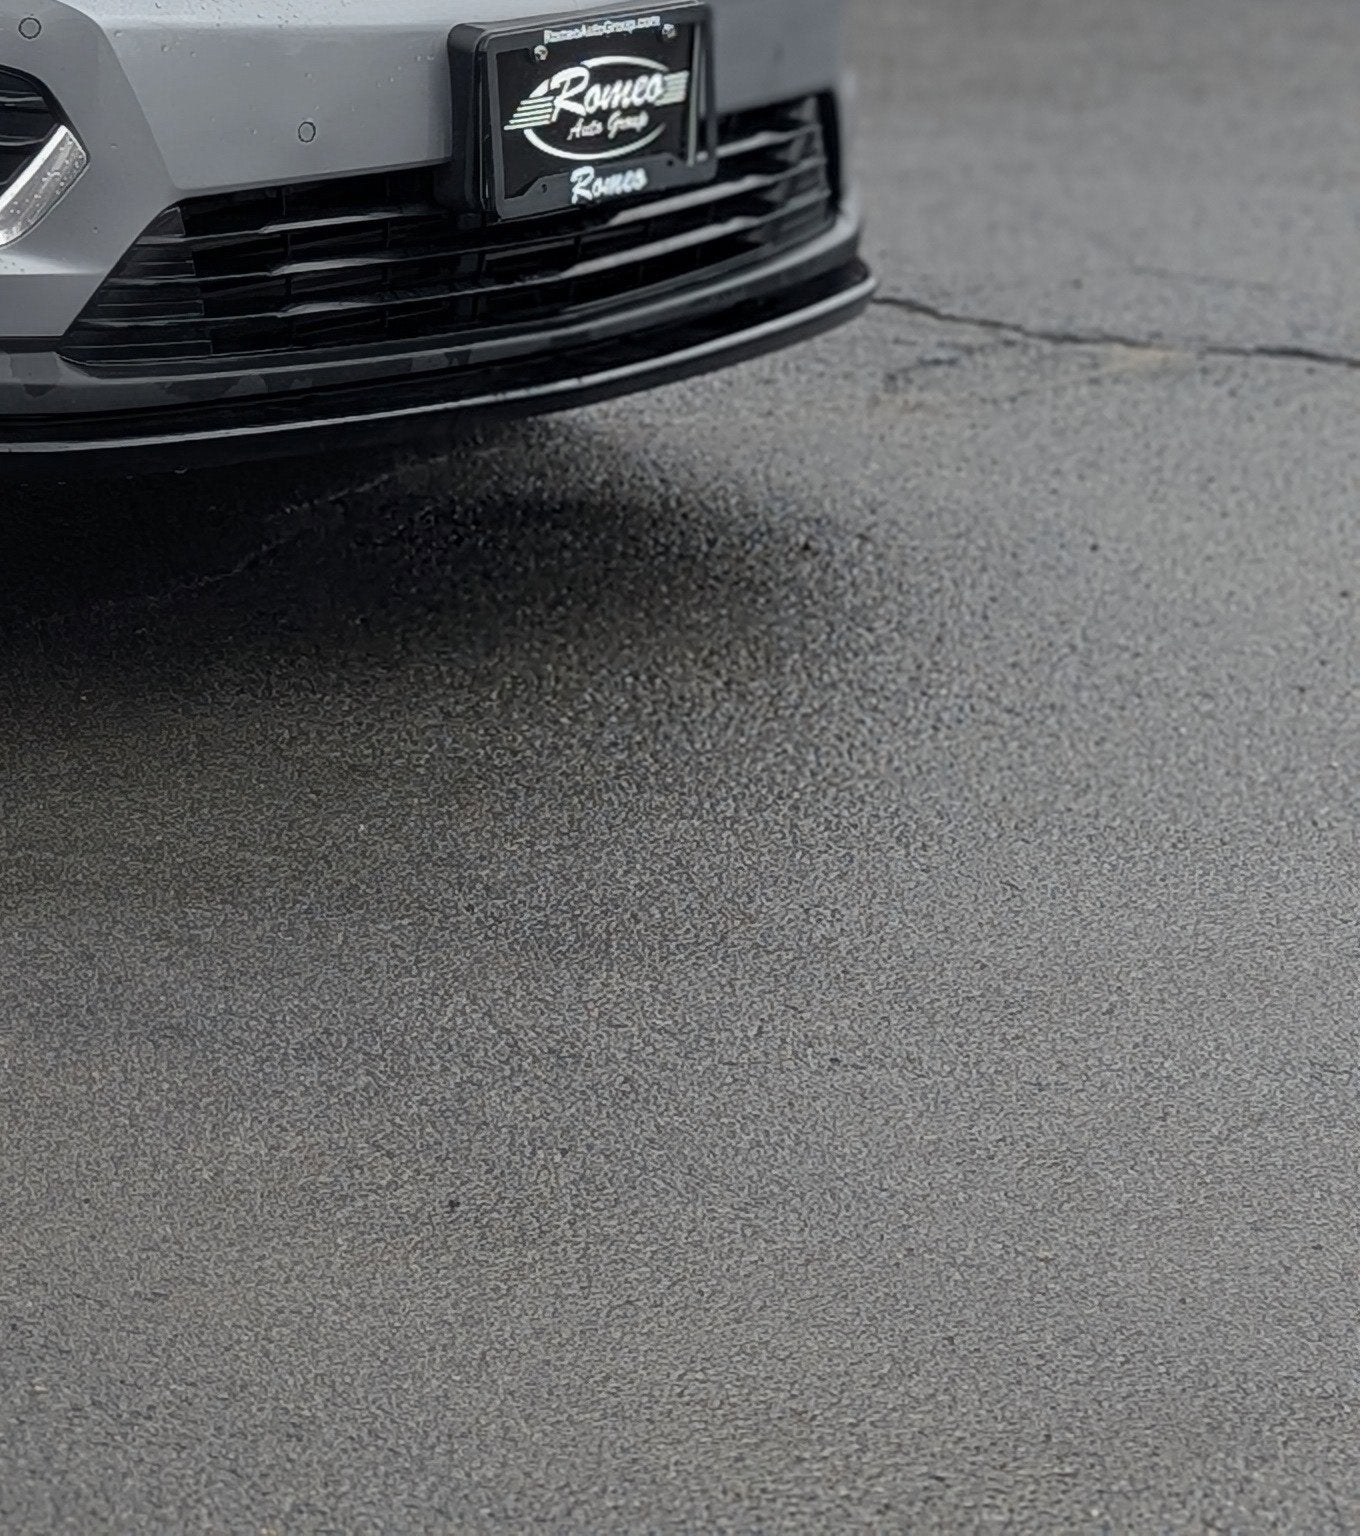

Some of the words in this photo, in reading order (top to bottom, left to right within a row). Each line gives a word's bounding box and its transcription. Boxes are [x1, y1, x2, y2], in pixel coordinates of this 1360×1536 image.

[550, 66, 665, 123] Romeo
[566, 117, 604, 141] Auto
[607, 110, 649, 140] Group
[569, 165, 649, 206] Romeo
